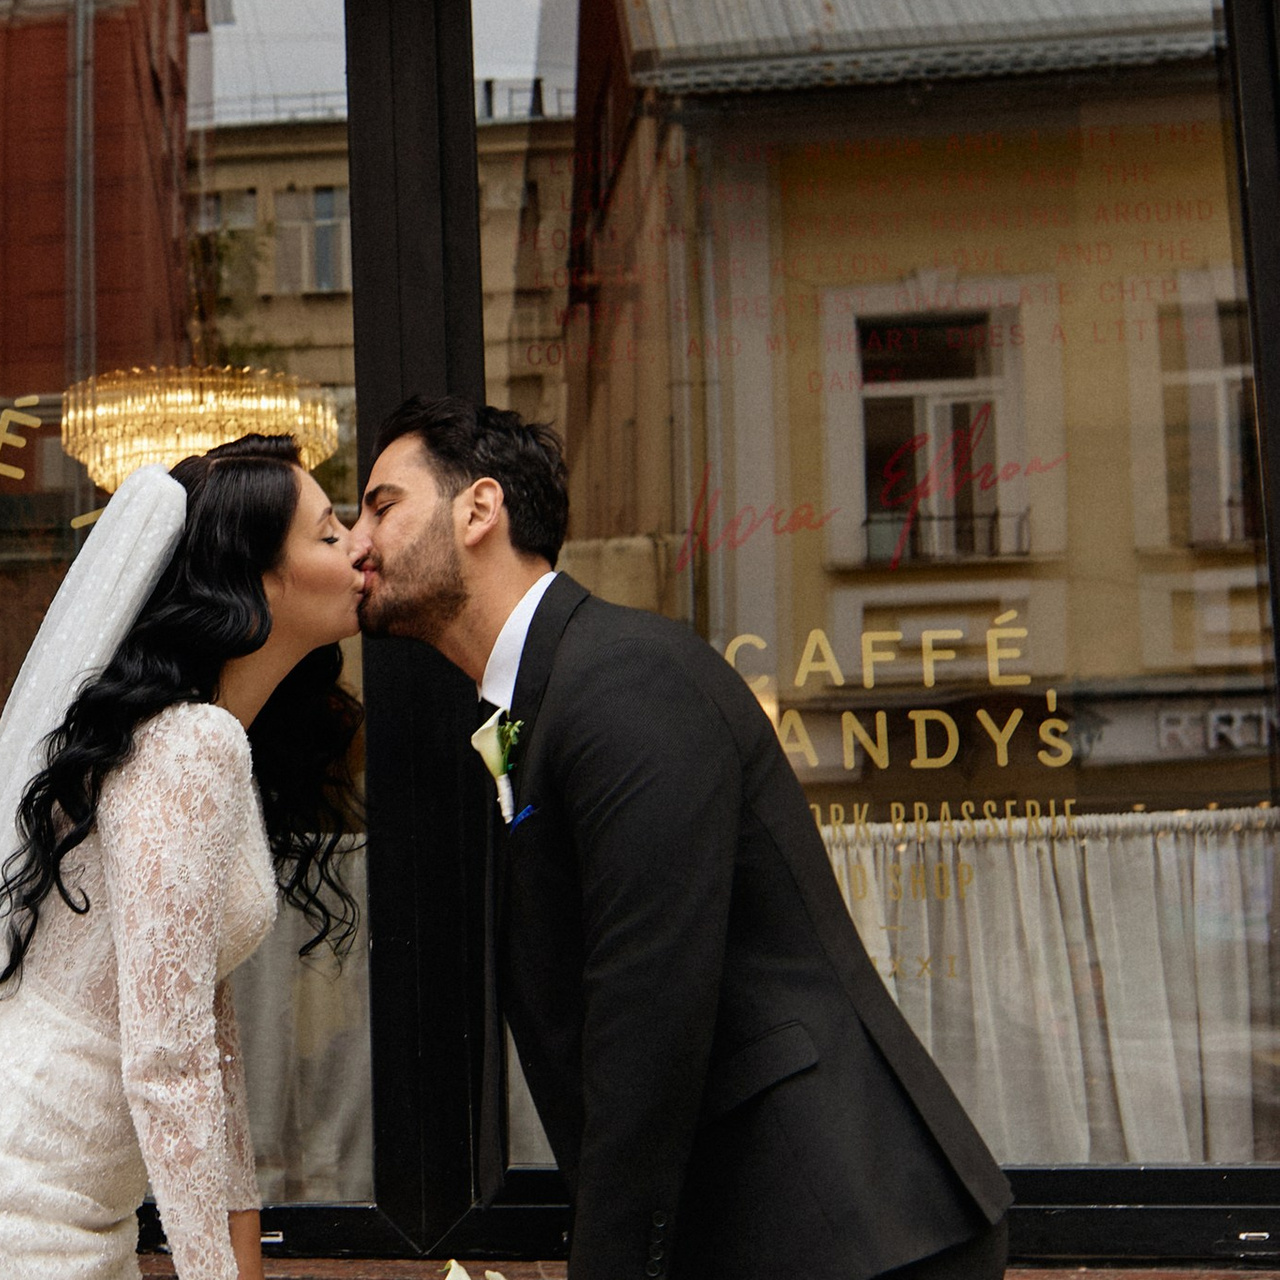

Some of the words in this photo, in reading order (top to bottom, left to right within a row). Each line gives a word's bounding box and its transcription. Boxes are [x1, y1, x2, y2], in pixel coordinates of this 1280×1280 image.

[945, 130, 1004, 157] AND
[1149, 120, 1209, 147] THE
[1019, 165, 1079, 193] AND
[1098, 160, 1159, 189] THE
[1094, 198, 1216, 227] AROUND
[1055, 238, 1116, 267] AND
[1137, 234, 1197, 264] THE
[1098, 277, 1180, 307] CHIP
[687, 332, 744, 361] AND
[765, 330, 803, 358] MY
[824, 325, 923, 357] HEART
[945, 322, 1028, 352] DOES
[1048, 321, 1068, 349] A
[1090, 315, 1213, 347] LITTLE
[723, 609, 1031, 690] CAFFÉ
[775, 688, 1074, 770] ANDY'S
[810, 802, 871, 843] RK
[890, 798, 1078, 839] BRASSERIE
[888, 862, 975, 901] SHOP
[870, 954, 959, 979] XXI
